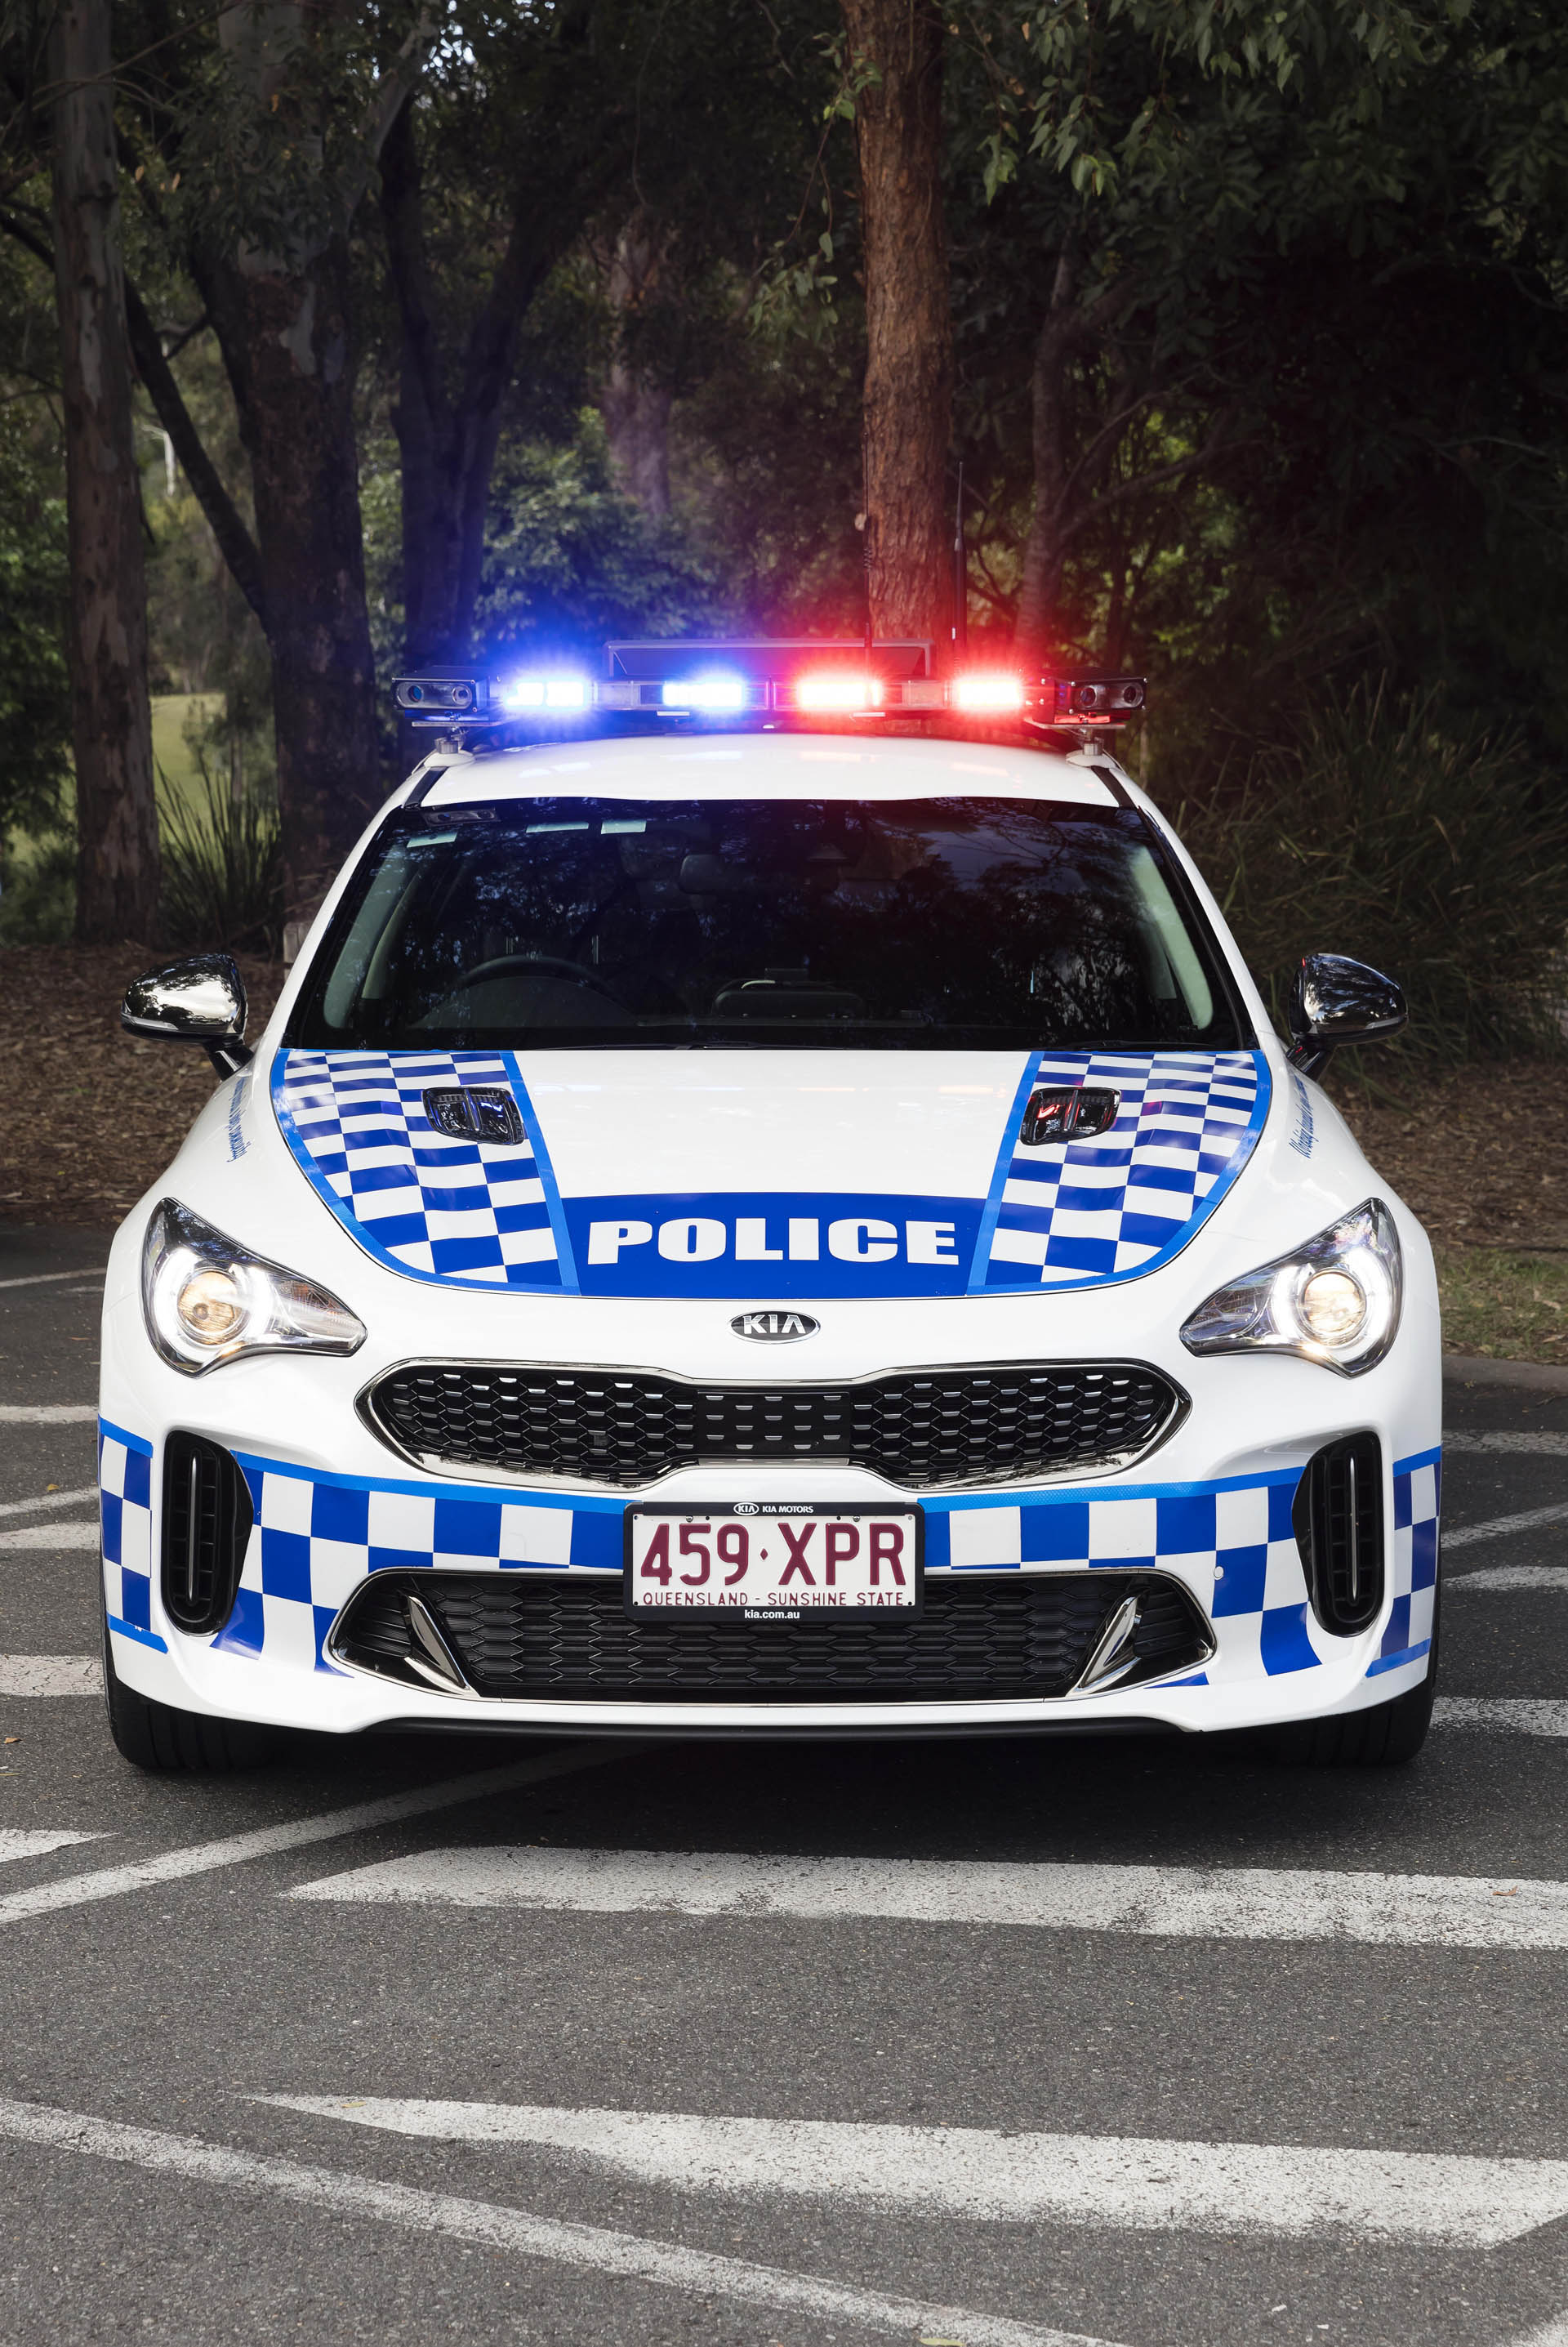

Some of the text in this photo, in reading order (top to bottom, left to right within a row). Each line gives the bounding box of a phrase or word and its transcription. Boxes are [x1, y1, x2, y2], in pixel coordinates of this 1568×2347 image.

[588, 1218, 959, 1265] POLICE
[742, 1314, 806, 1335] KIA
[762, 1506, 813, 1514] KIA MOTORS
[643, 1592, 748, 1606] QUEENSLAND
[768, 1592, 847, 1606] SUNSHINE
[857, 1592, 903, 1606] STATE
[744, 1609, 800, 1620] kia.com.au
